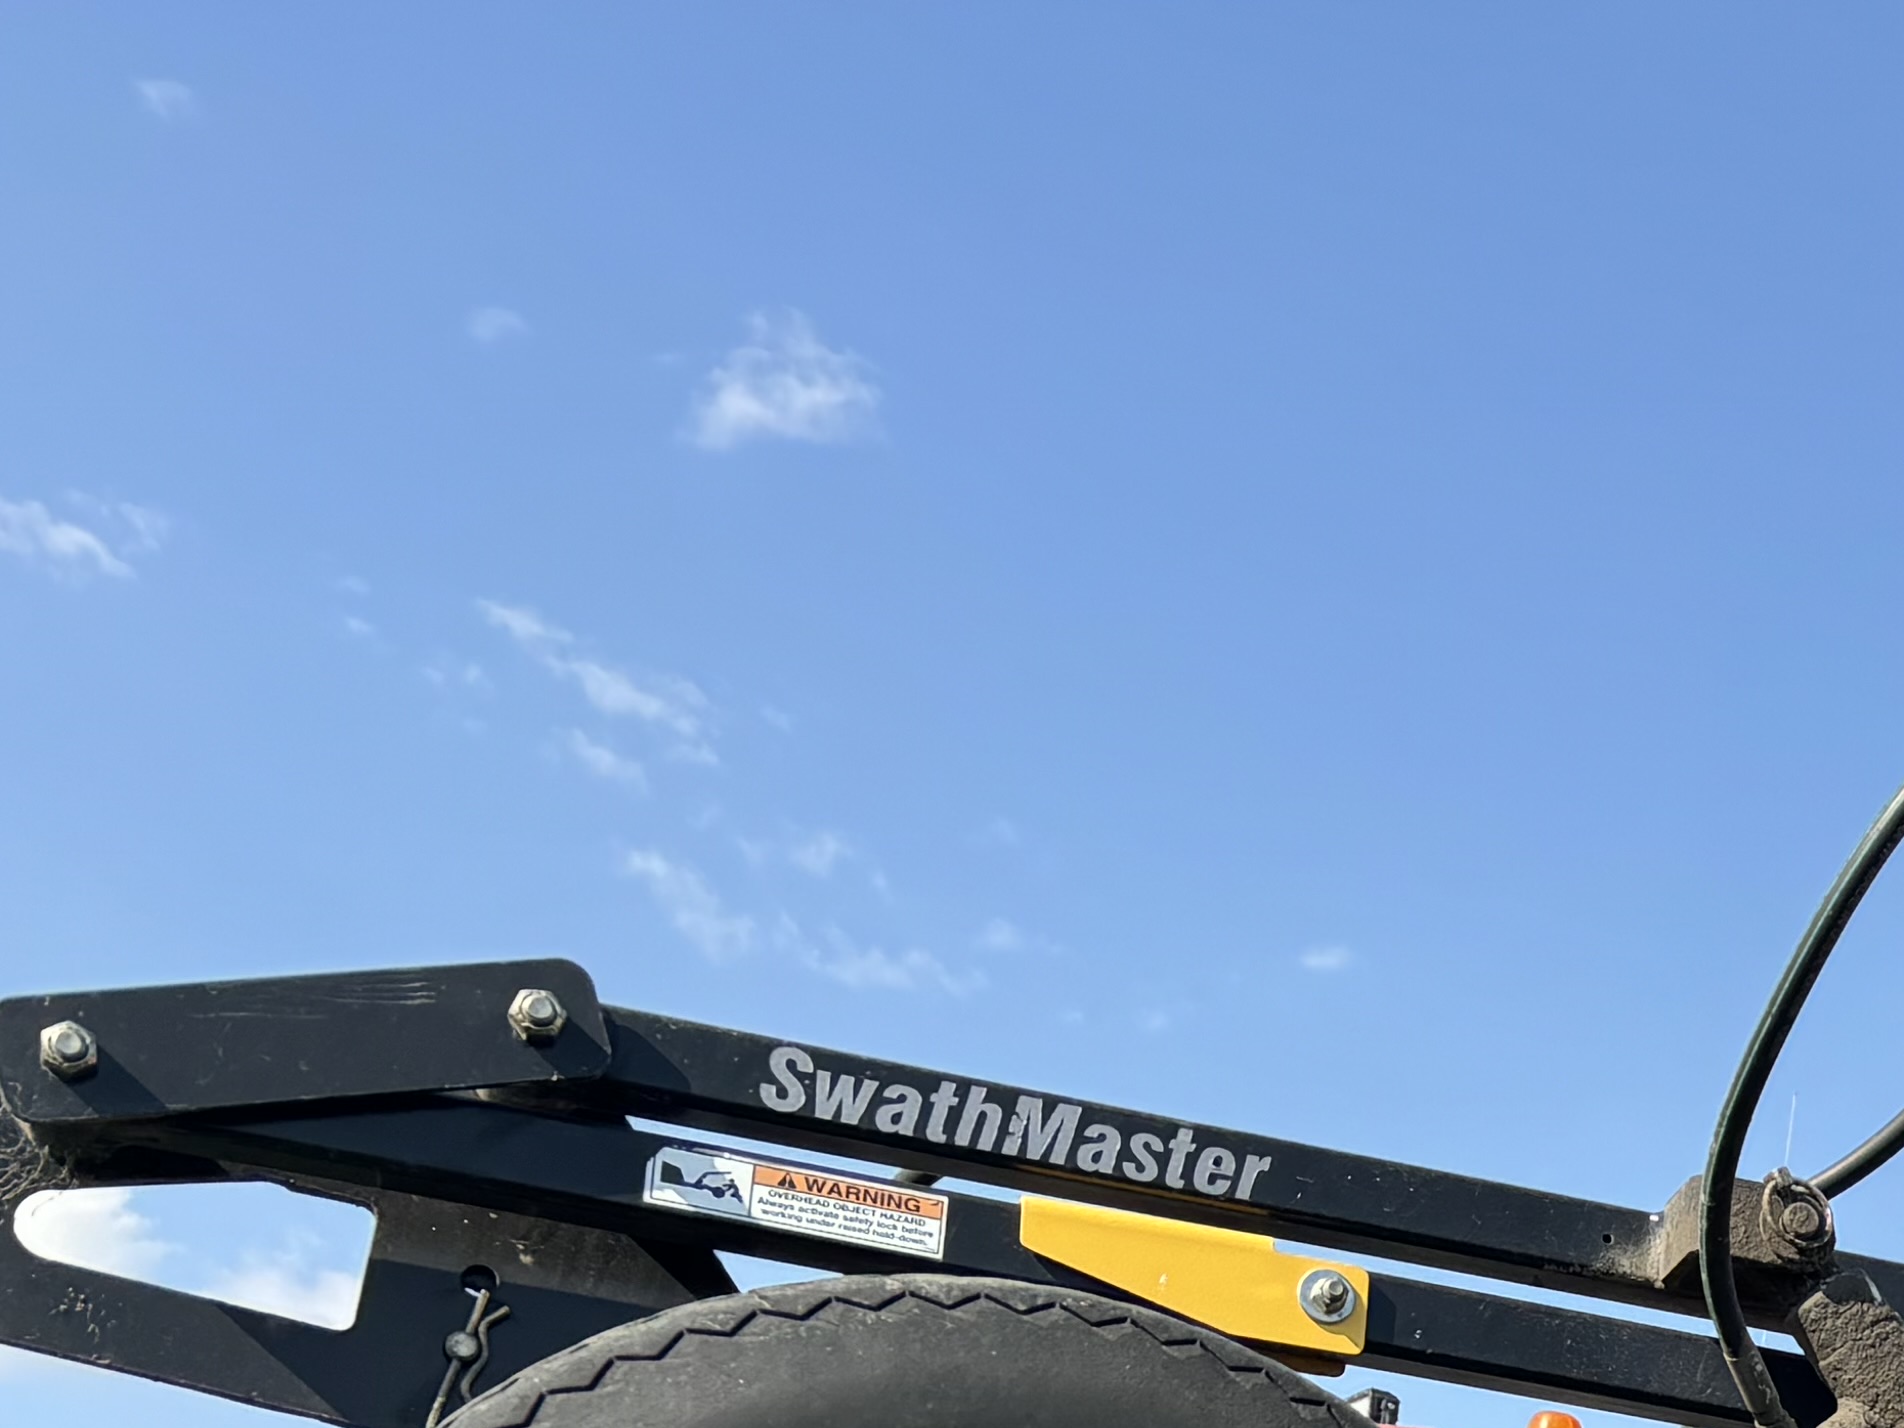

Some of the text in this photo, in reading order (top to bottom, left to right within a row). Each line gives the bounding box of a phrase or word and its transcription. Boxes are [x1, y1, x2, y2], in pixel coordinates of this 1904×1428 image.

[759, 1046, 1273, 1201] SwathMaster
[768, 1189, 926, 1228] OVERHEAD OBJECT HAZARD
[804, 1176, 921, 1213] WARNING
[757, 1196, 934, 1238] Always activate safety lock before
[761, 1208, 803, 1224] working
[806, 1216, 836, 1228] under
[838, 1222, 870, 1235] raised
